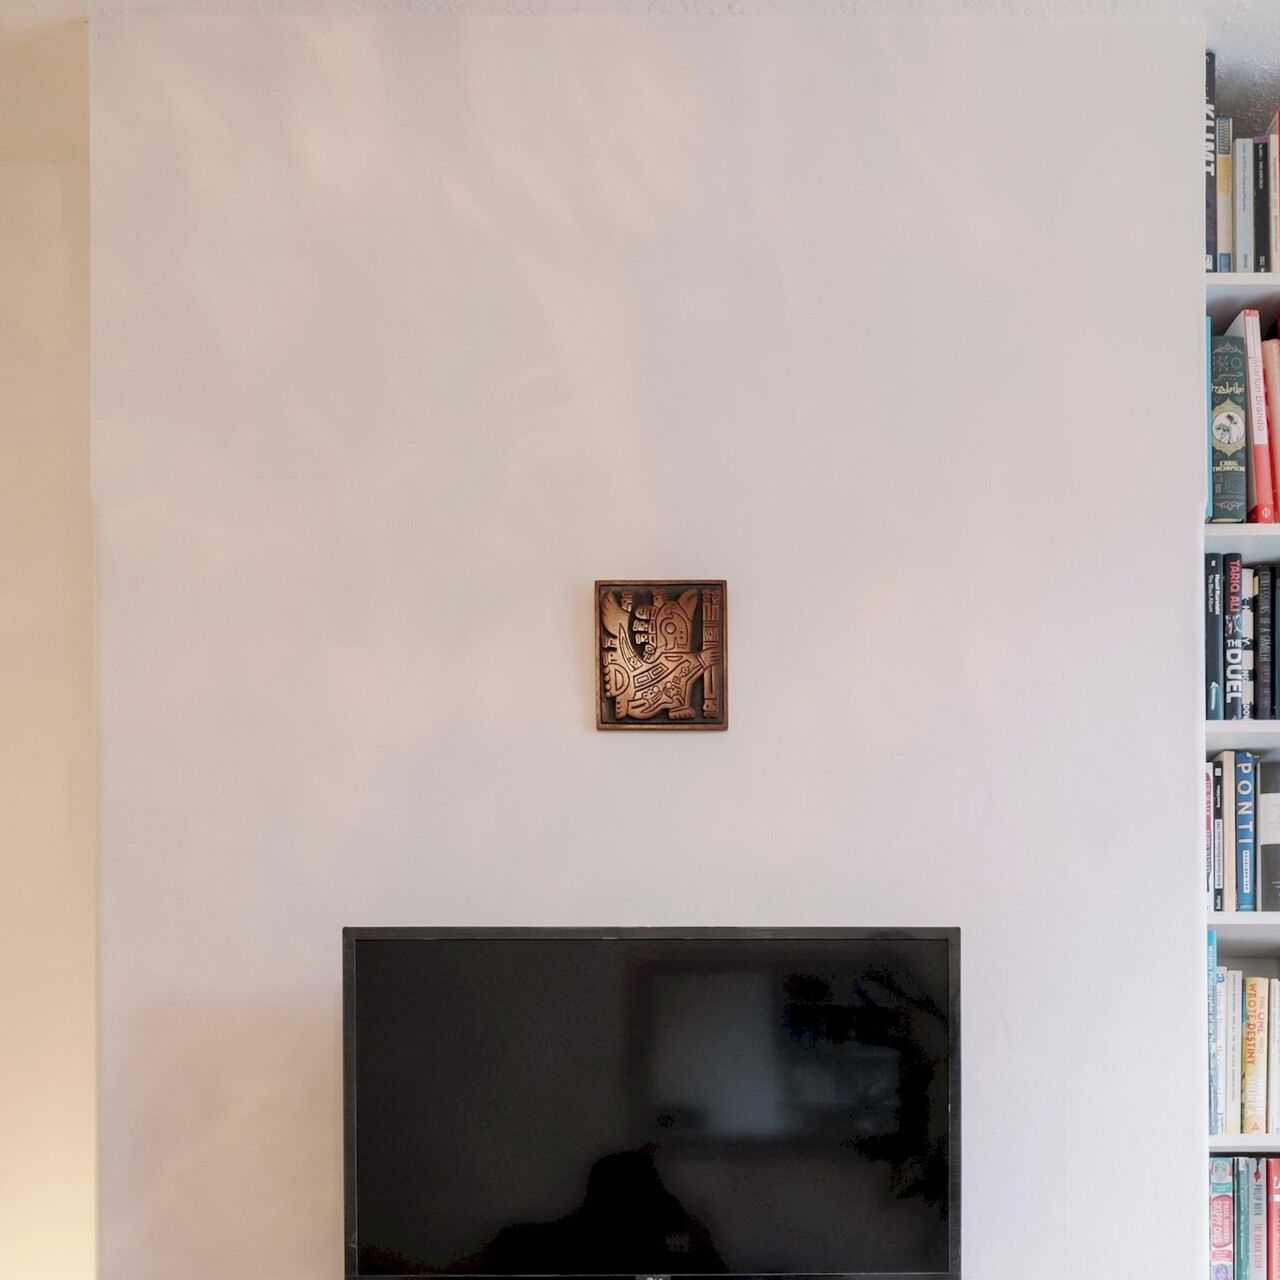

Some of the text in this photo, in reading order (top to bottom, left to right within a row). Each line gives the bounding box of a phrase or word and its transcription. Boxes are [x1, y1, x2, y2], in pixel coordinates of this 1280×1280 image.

[1230, 560, 1240, 612] TARIQ ALI
[1226, 639, 1243, 648] THE
[1225, 649, 1242, 703] DUEL
[1237, 763, 1253, 844] PONTI
[1247, 983, 1256, 1066] WROTE DESTINY
